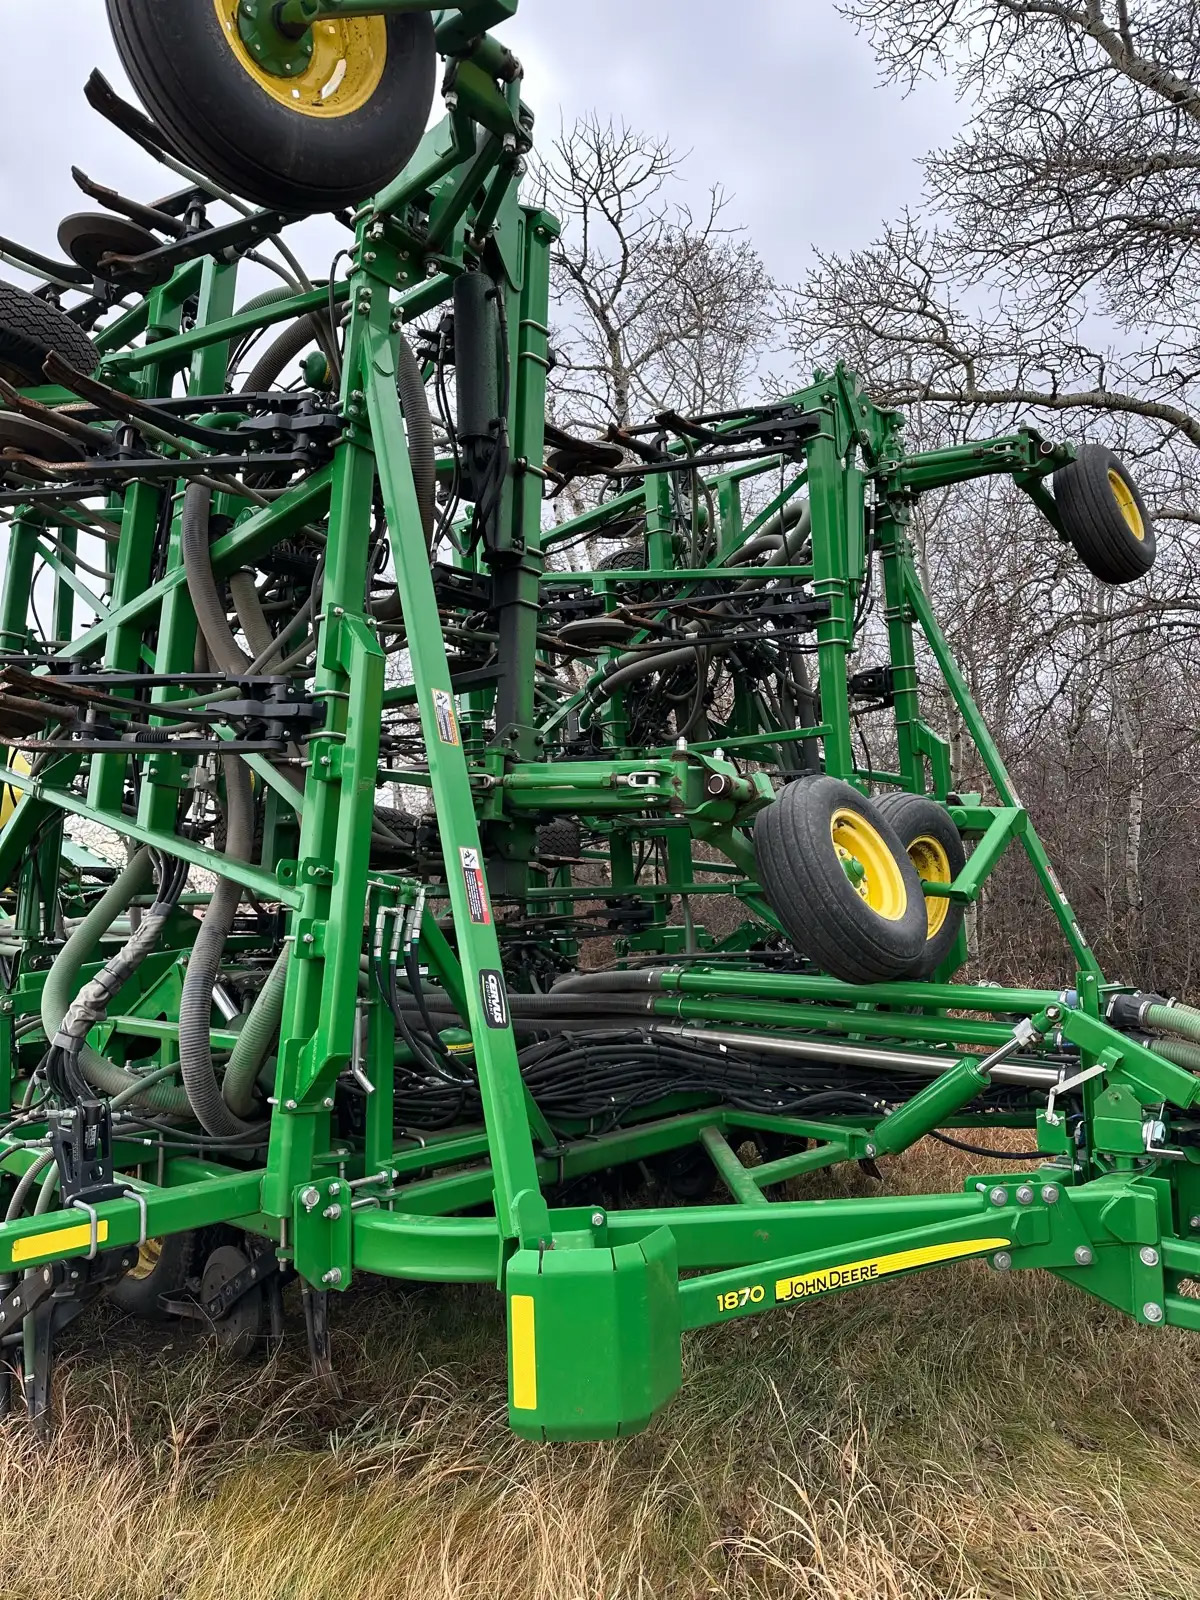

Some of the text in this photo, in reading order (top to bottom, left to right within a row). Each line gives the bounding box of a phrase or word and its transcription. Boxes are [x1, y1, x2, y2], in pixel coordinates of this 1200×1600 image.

[479, 888, 488, 912] DANGER
[485, 980, 494, 1015] EQUIPMENT
[488, 974, 503, 1024] CERVUS
[716, 1285, 765, 1312] 1870
[785, 1264, 879, 1299] JOHN DEERE
